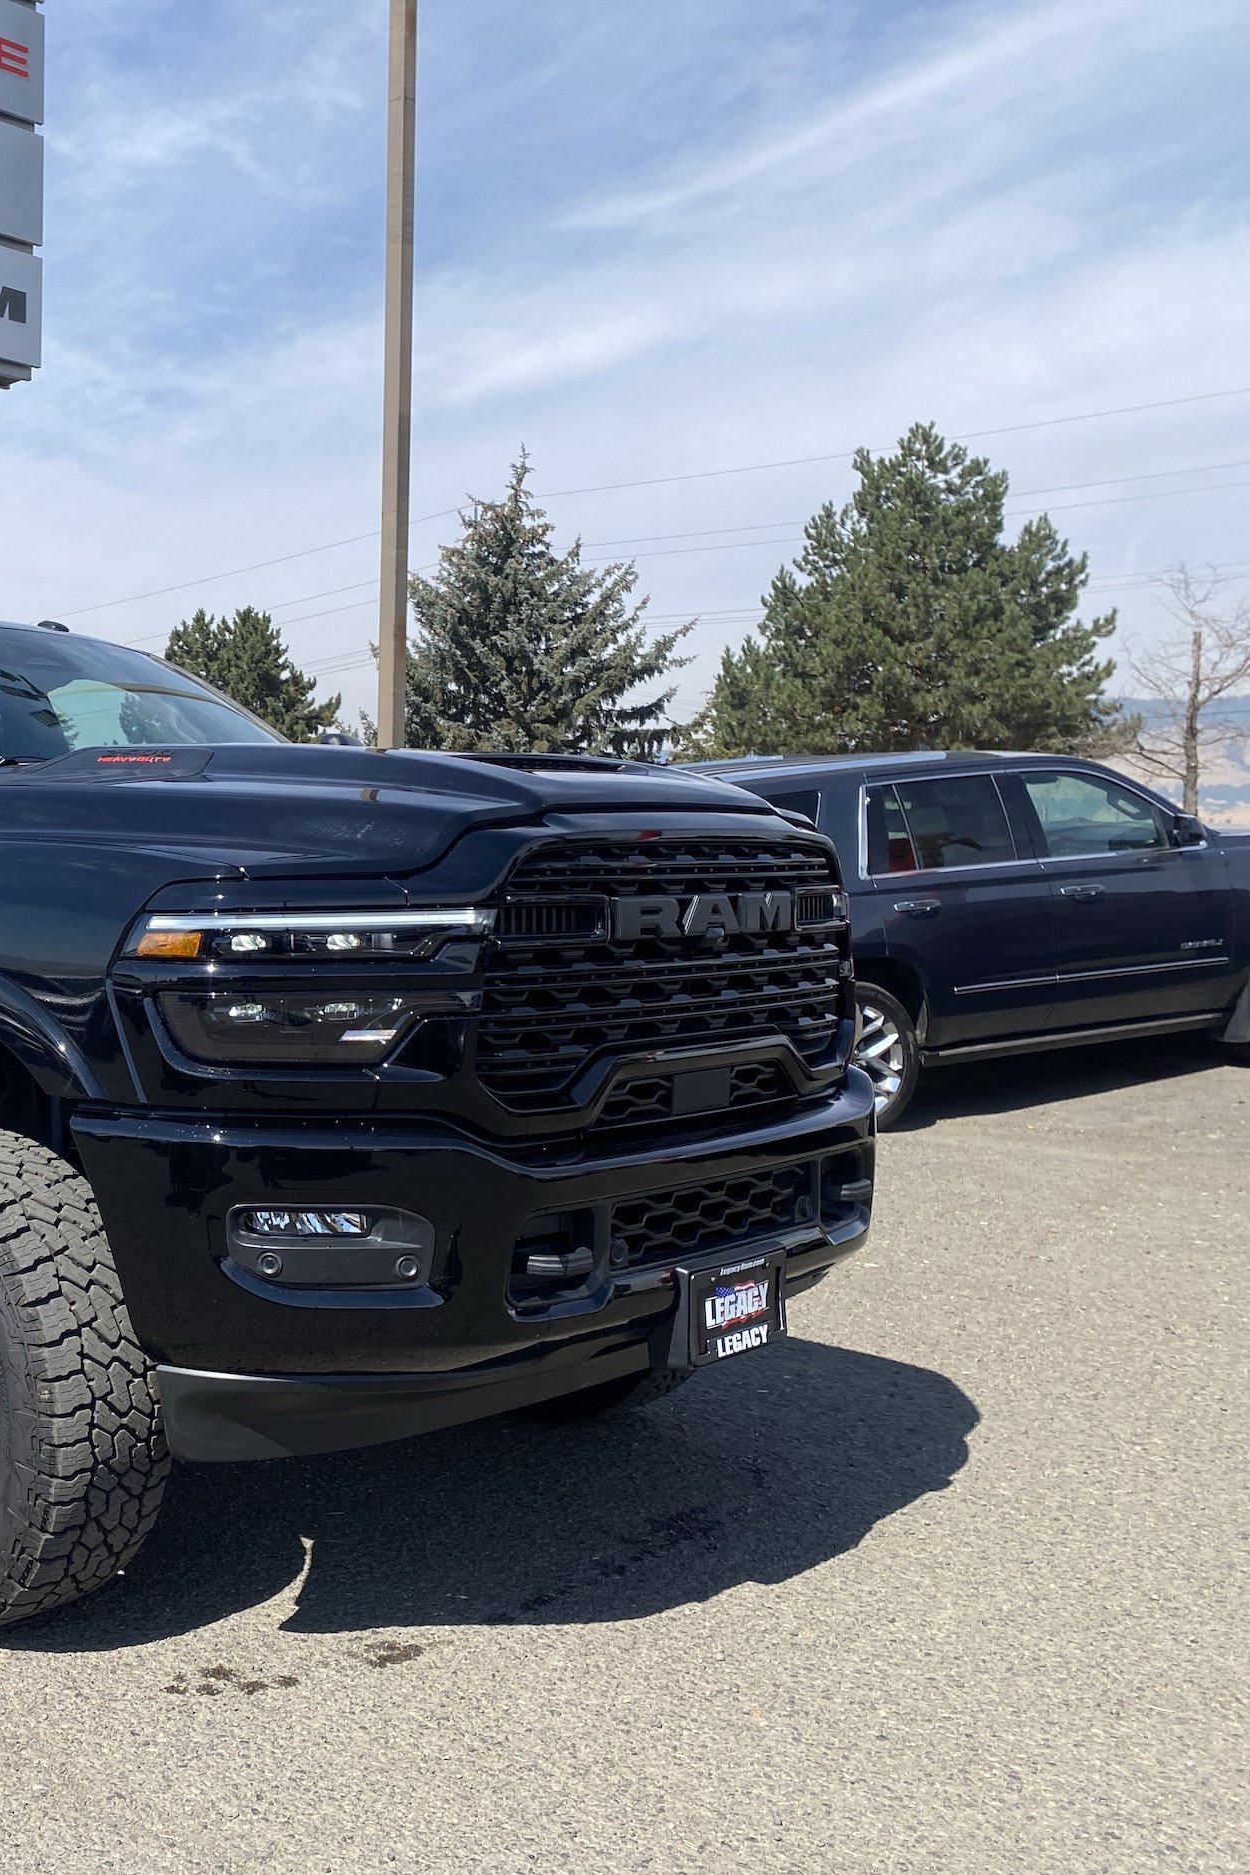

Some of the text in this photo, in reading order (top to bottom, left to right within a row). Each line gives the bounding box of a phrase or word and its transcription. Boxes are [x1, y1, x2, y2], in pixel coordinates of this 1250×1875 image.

[610, 891, 793, 942] RAM
[705, 1282, 770, 1328] LEGACY
[716, 1324, 769, 1358] LEGACY
